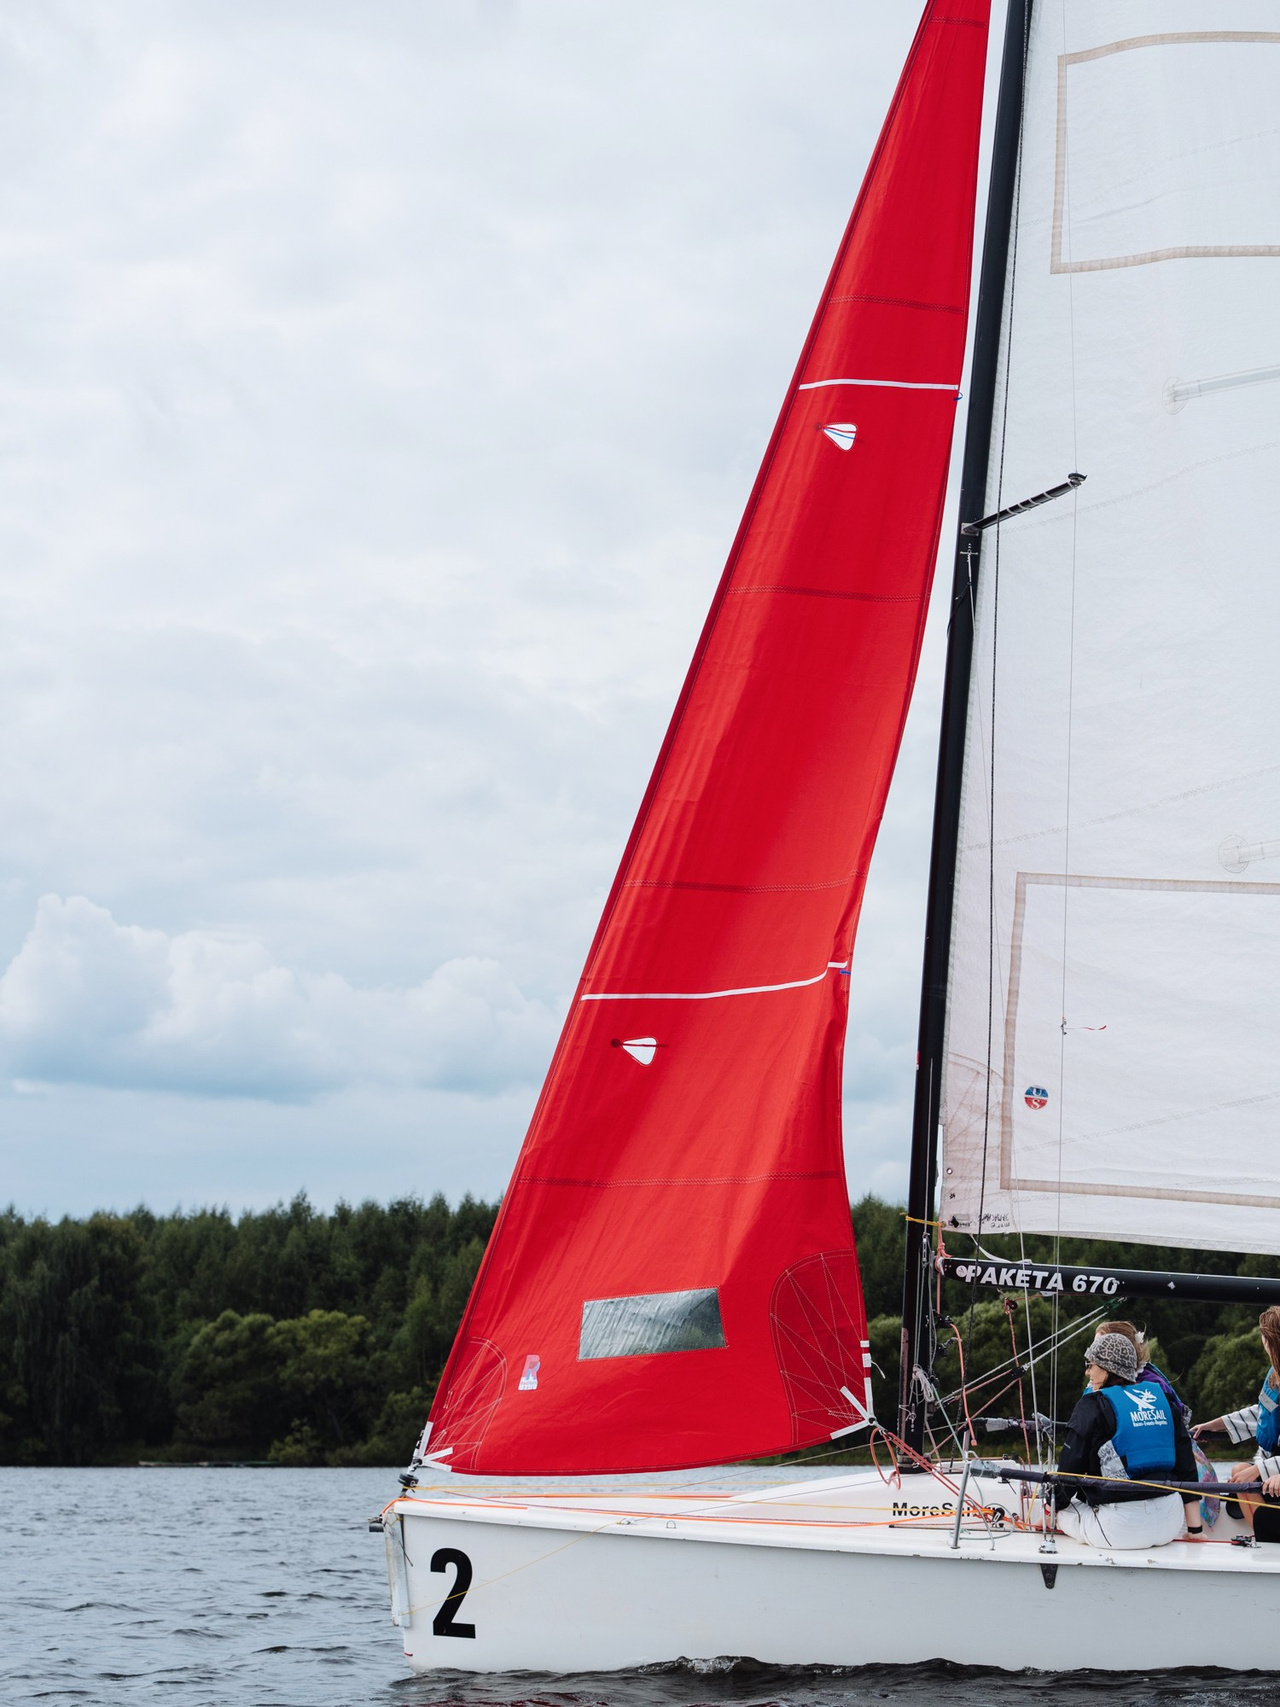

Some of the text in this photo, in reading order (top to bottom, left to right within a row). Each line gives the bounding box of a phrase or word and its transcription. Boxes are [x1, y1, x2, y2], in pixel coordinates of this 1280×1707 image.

[1072, 1274, 1119, 1295] 670
[1130, 1409, 1167, 1422] MORESAIL
[430, 1547, 477, 1639] 2
